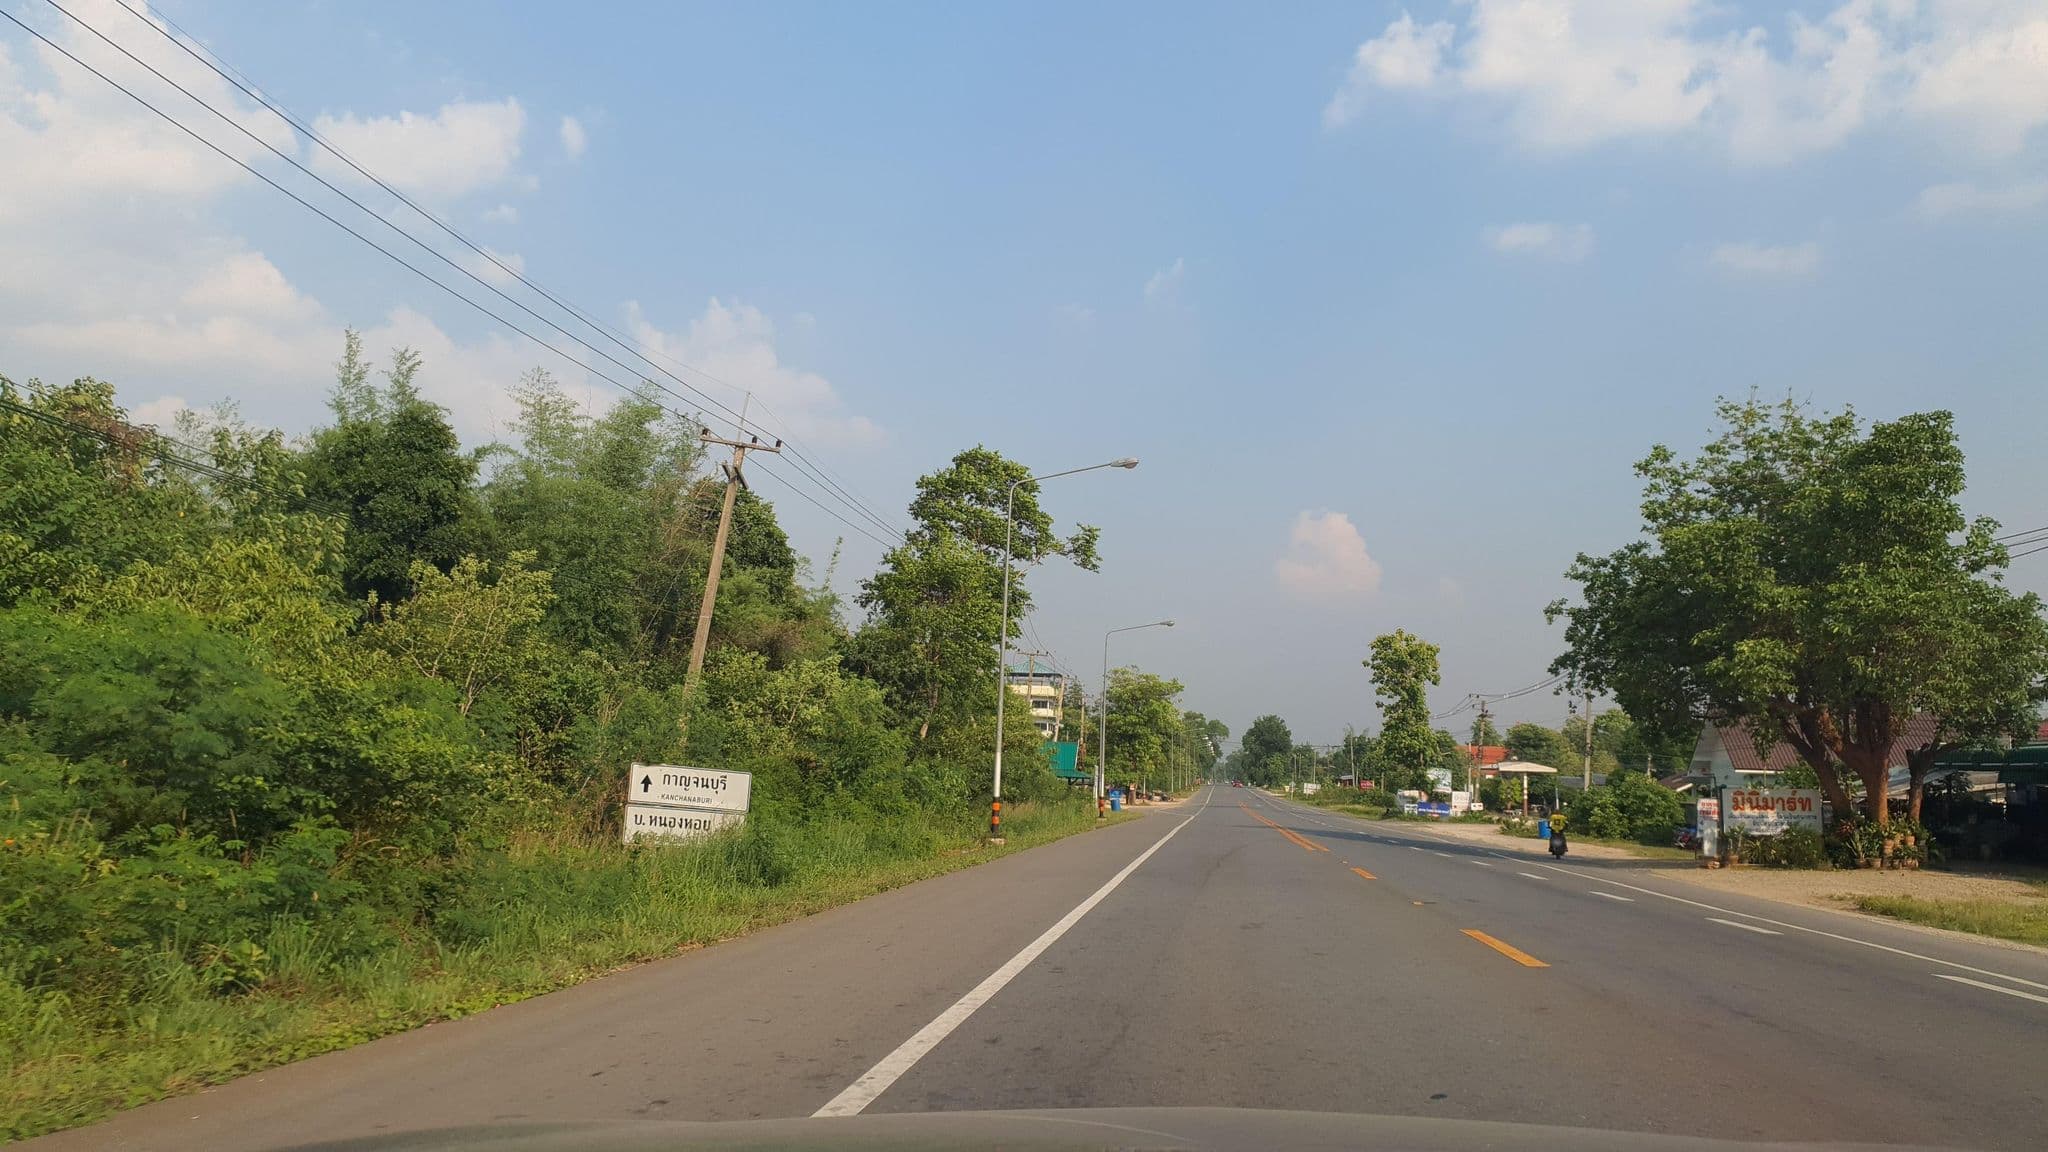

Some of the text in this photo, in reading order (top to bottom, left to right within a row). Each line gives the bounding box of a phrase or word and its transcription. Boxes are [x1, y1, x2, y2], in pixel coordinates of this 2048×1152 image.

[663, 774, 727, 794] กาญจนบุรี
[661, 794, 712, 804] KANCHANABURI
[1732, 790, 1812, 811] มินิมาร์ท
